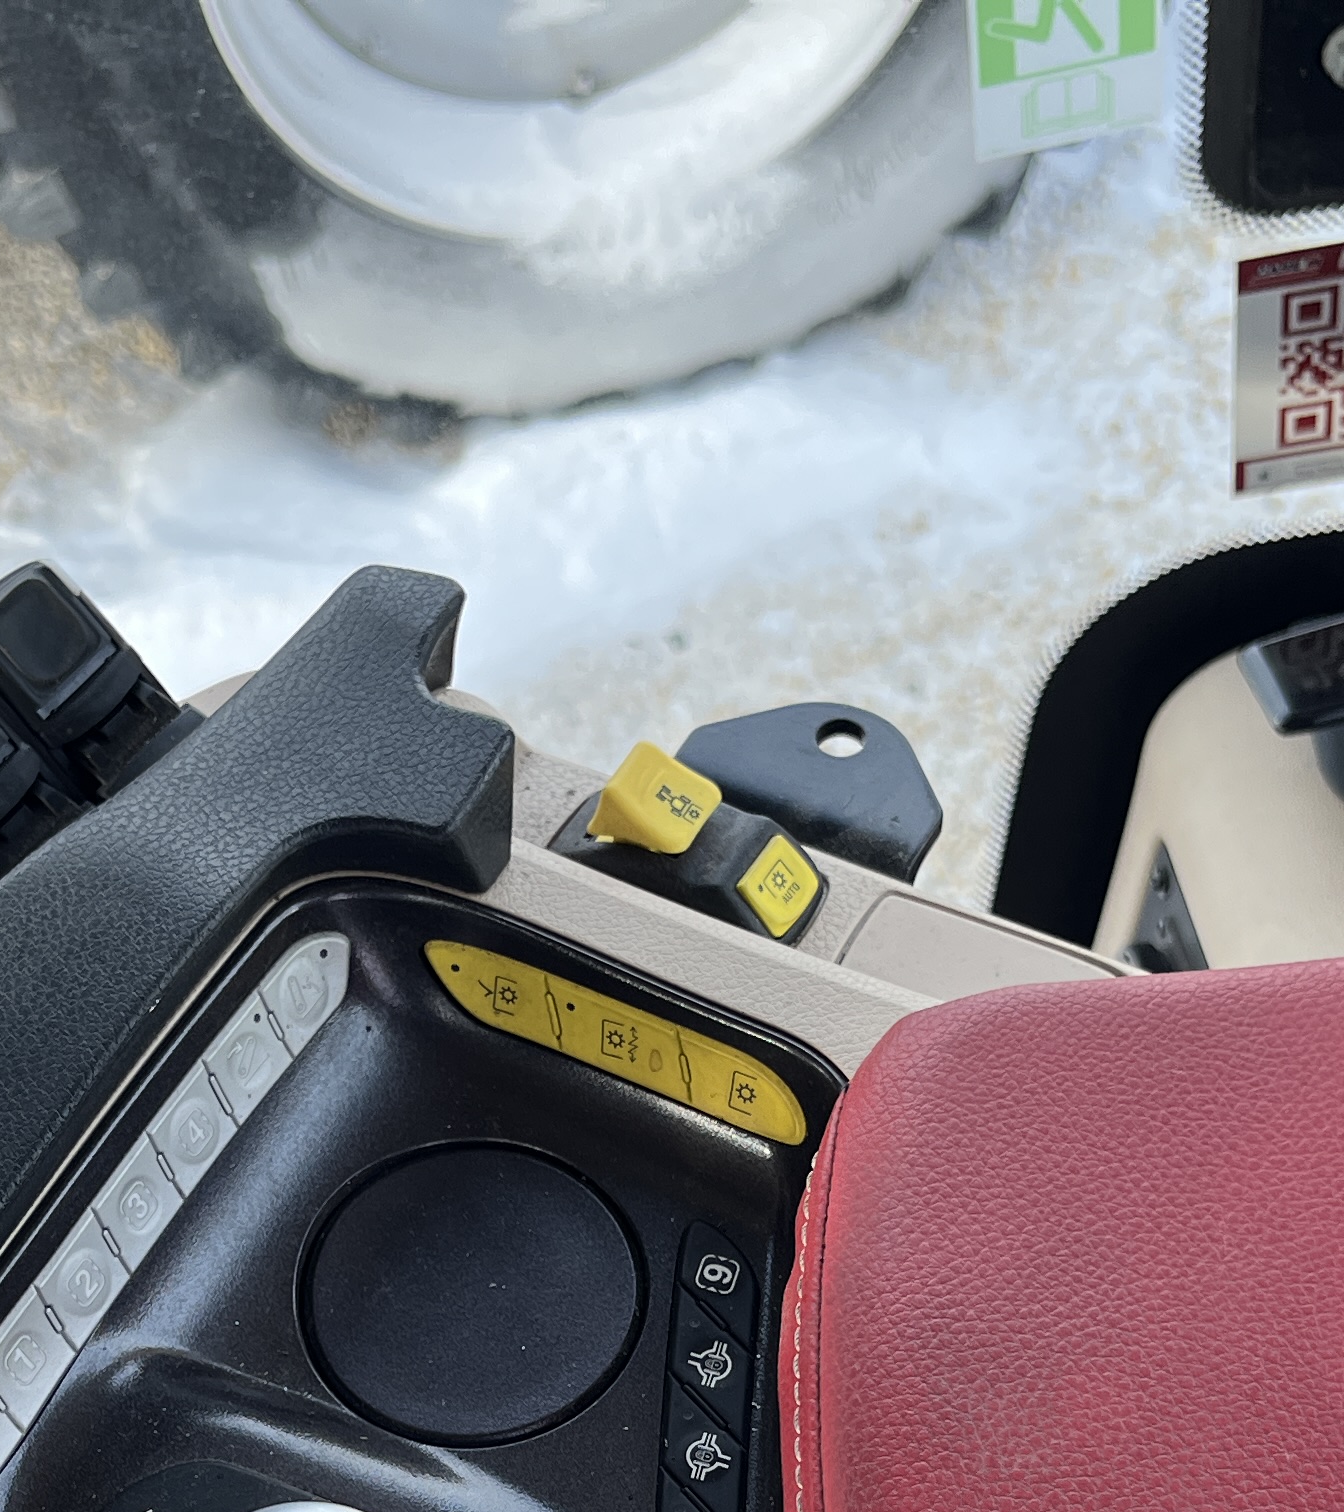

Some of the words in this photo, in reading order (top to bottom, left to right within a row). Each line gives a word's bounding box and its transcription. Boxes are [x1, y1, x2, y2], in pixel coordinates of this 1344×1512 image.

[782, 881, 801, 905] AUTO
[188, 1118, 207, 1143] 4
[127, 1192, 149, 1219] 3
[75, 1269, 99, 1299] 2
[13, 1347, 36, 1371] 1
